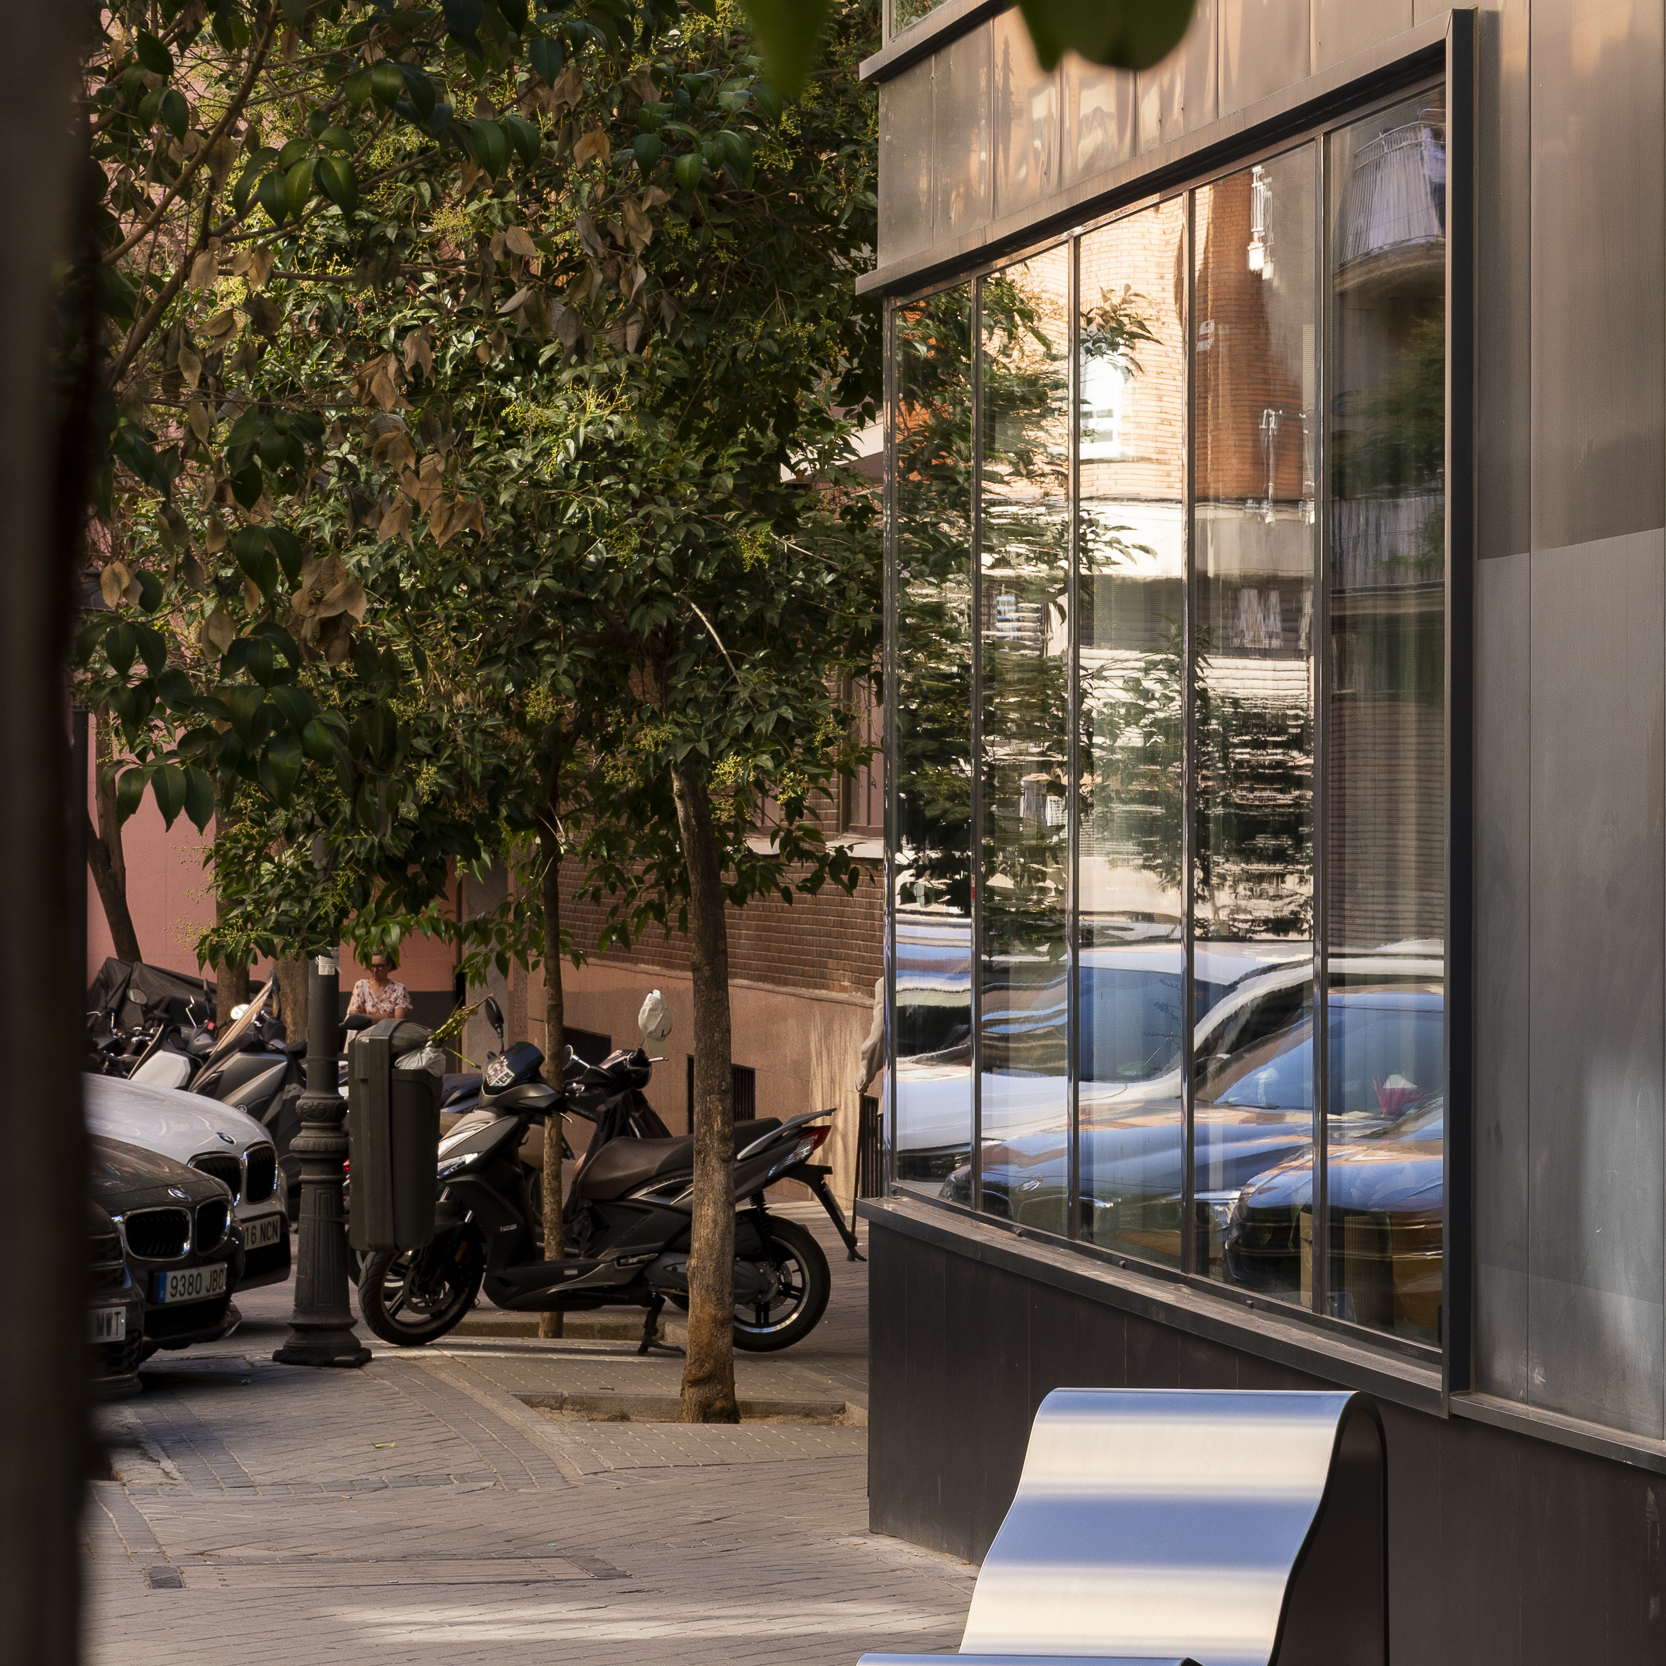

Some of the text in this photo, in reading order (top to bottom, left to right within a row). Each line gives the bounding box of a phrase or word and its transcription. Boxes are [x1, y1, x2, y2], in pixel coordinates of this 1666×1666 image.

[260, 1219, 279, 1243] NCN
[169, 1268, 225, 1298] 9380 JBC
